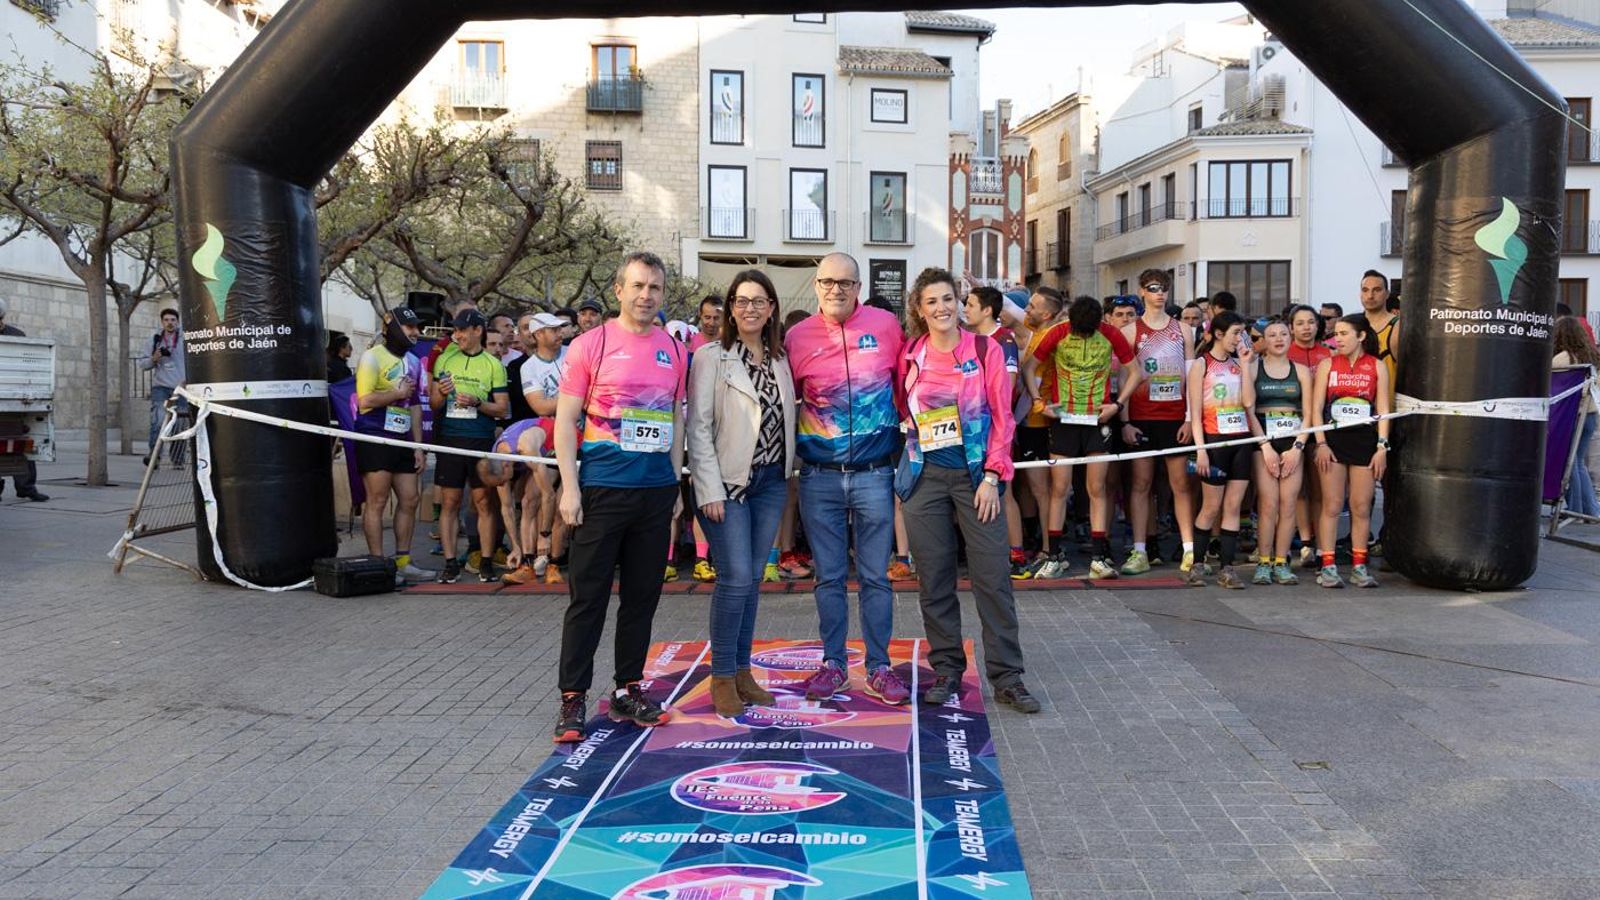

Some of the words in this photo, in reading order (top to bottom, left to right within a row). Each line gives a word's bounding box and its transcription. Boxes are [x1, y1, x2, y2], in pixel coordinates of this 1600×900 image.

[1429, 308, 1493, 321] Patronato
[1496, 308, 1547, 326] Municipal
[216, 323, 274, 338] Municipal
[276, 324, 292, 336] de
[1444, 321, 1506, 336] Deportes
[1508, 322, 1525, 336] de
[1526, 325, 1549, 339] Jaén
[187, 340, 226, 355] Deportes
[228, 338, 245, 350] de
[247, 337, 278, 350] Jaén
[1159, 385, 1175, 393] 627
[1342, 407, 1360, 415] 652
[636, 426, 660, 439] 575
[932, 421, 958, 436] 774
[562, 728, 615, 771] TEAMERGY
[675, 740, 875, 751] #somoselcambio
[945, 728, 972, 773] TEAMERGY
[684, 784, 720, 793] IES
[705, 793, 772, 801] Fuente
[488, 797, 554, 860] TEAMERGY
[954, 799, 988, 862] TEAMERGY
[617, 831, 867, 846] #somoselcambio
